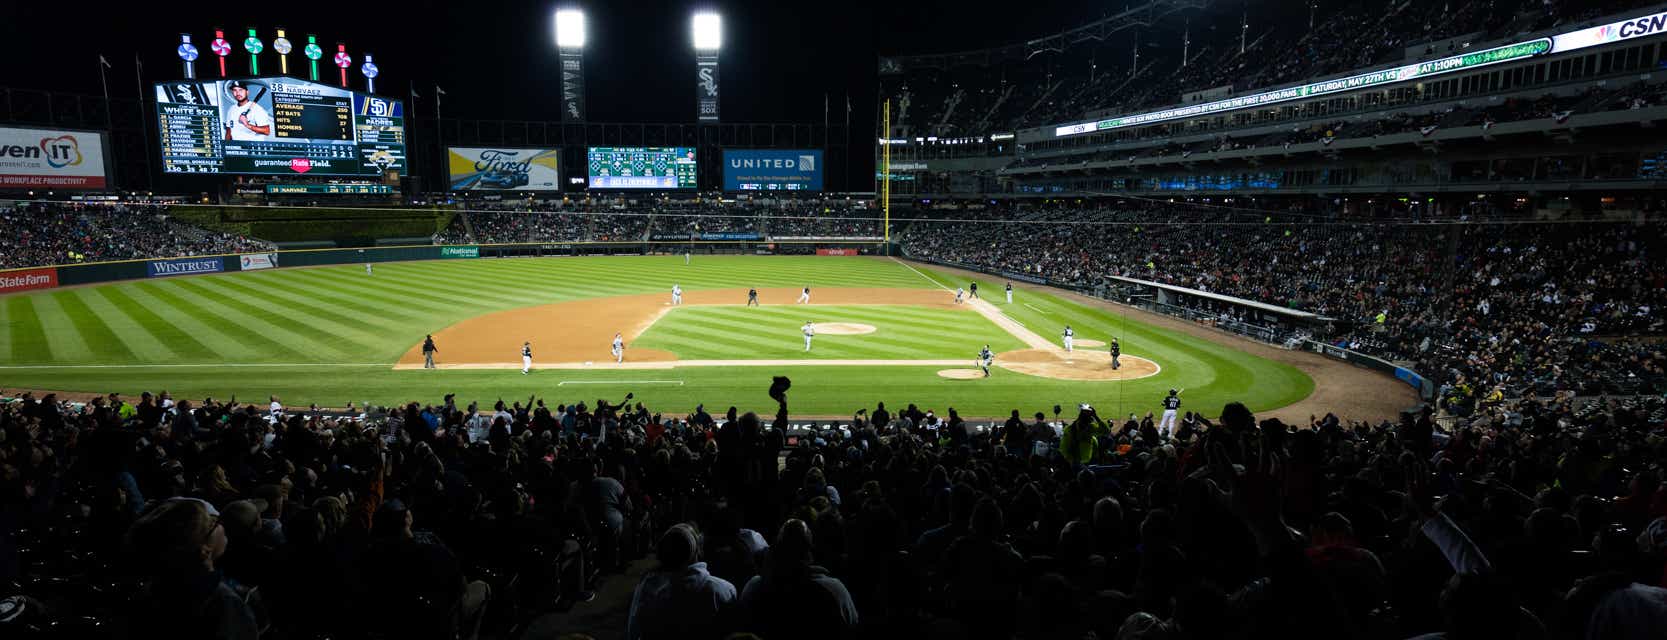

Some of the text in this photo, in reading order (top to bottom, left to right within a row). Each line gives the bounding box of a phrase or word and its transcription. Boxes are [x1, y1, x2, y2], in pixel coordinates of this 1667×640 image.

[1619, 14, 1667, 38] CSN
[1421, 64, 1431, 74] AT
[1434, 58, 1463, 72] 1:10PM
[1348, 76, 1364, 87] MAY
[1364, 73, 1384, 84] 27TH
[1385, 71, 1396, 81] VS
[271, 83, 283, 92] 38
[1220, 101, 1232, 109] FOR
[1243, 96, 1258, 105] FIRST
[1260, 94, 1280, 103] 20,000
[1280, 89, 1297, 99] FANS
[164, 107, 214, 117] WHITE SOX
[51, 145, 71, 160] IT
[475, 150, 533, 173] Ford
[731, 159, 795, 168] UNITED
[3, 177, 43, 185] WORKPLACE
[449, 247, 478, 255] National
[153, 260, 218, 273] WINTRUST
[26, 275, 50, 285] Farm
